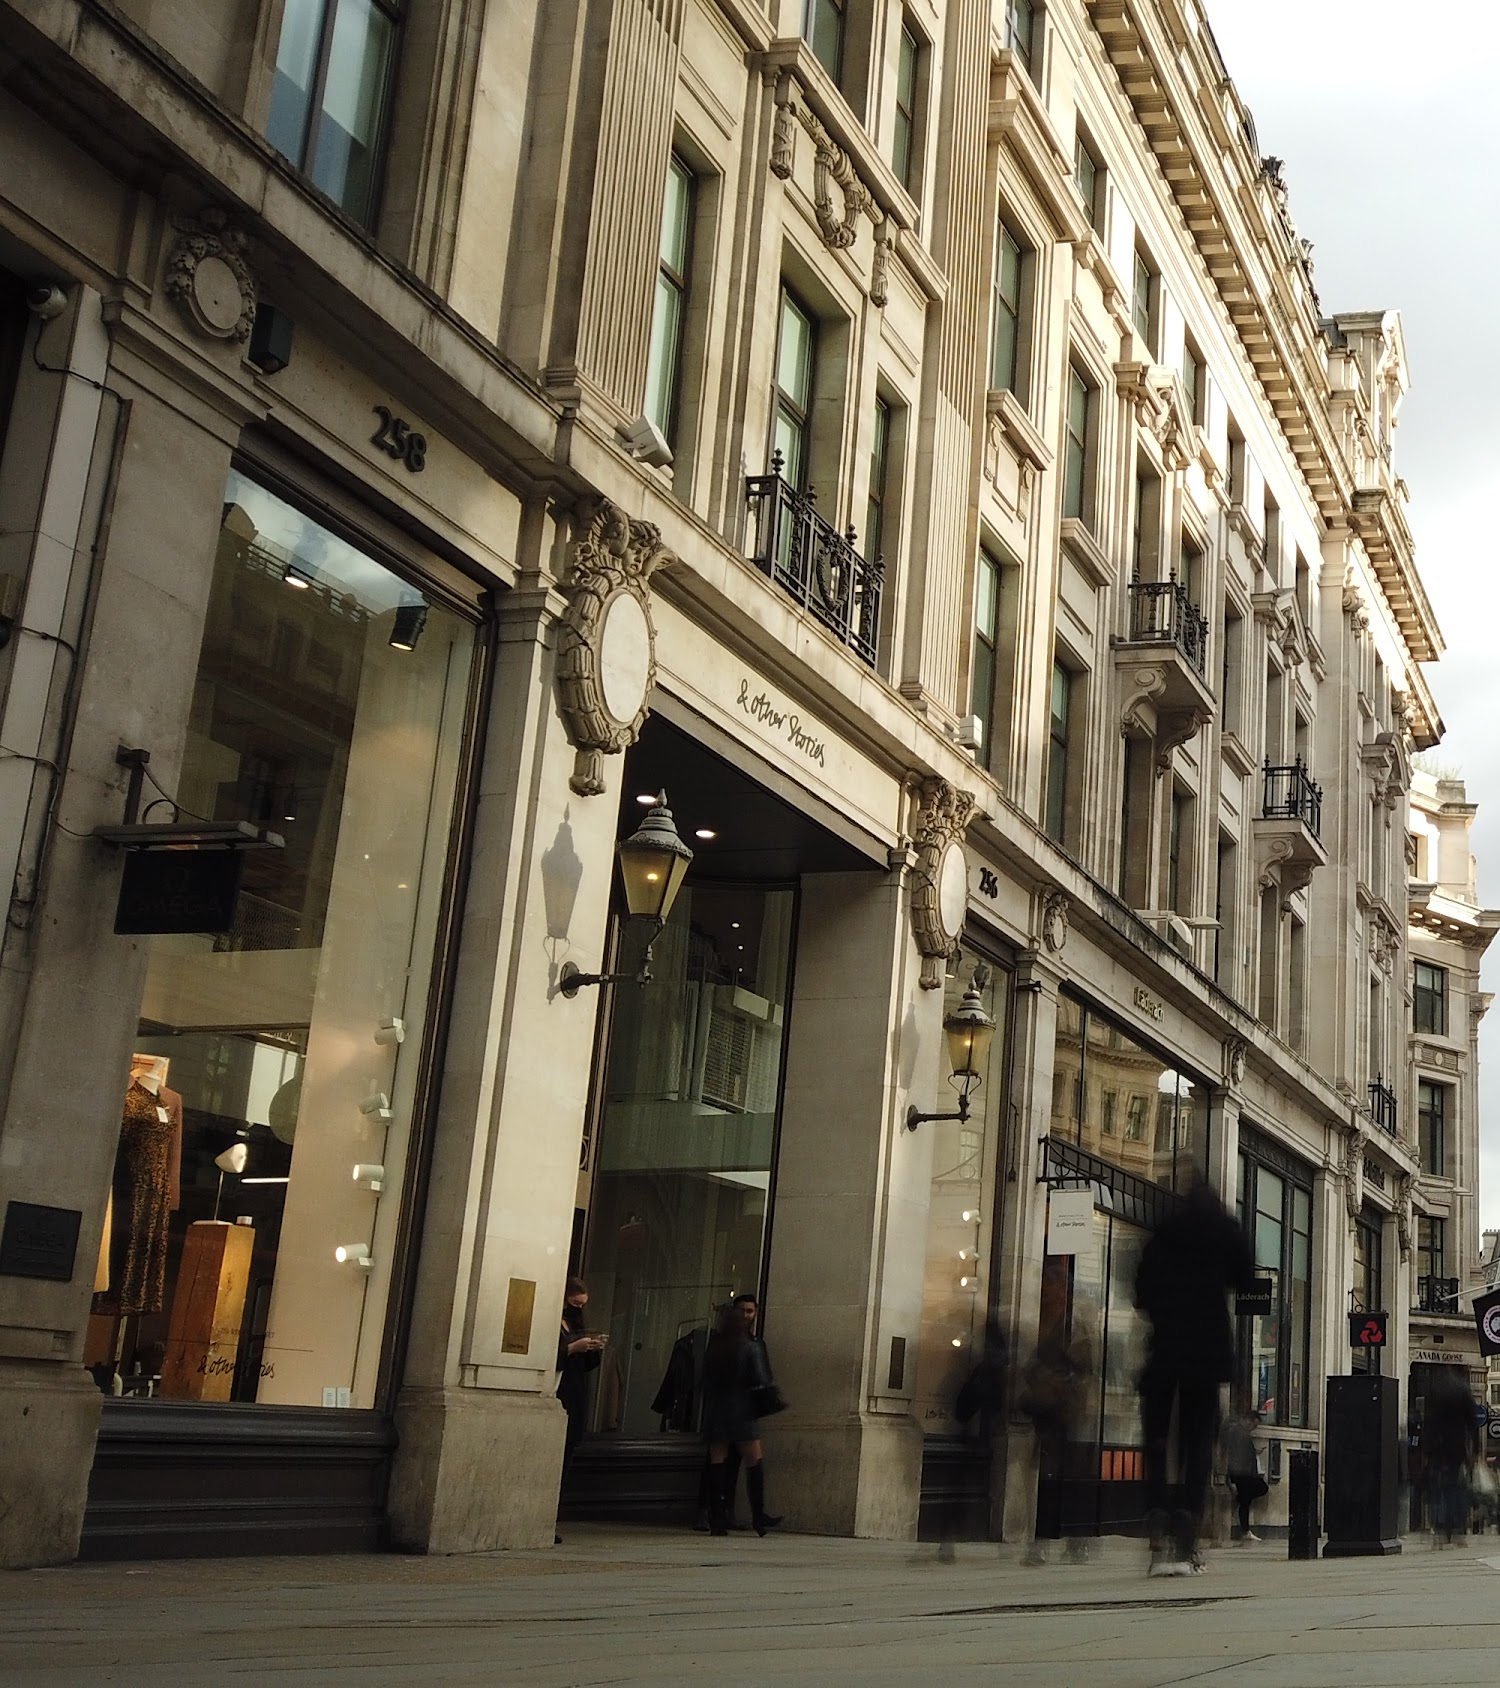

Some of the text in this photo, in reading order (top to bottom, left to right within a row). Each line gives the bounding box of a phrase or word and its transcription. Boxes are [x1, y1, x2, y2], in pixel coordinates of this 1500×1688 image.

[370, 405, 427, 473] 258
[737, 678, 825, 768] & other Stories
[979, 867, 998, 899] 256
[1236, 1292, 1270, 1301] Läderach
[210, 1356, 237, 1375] othe
